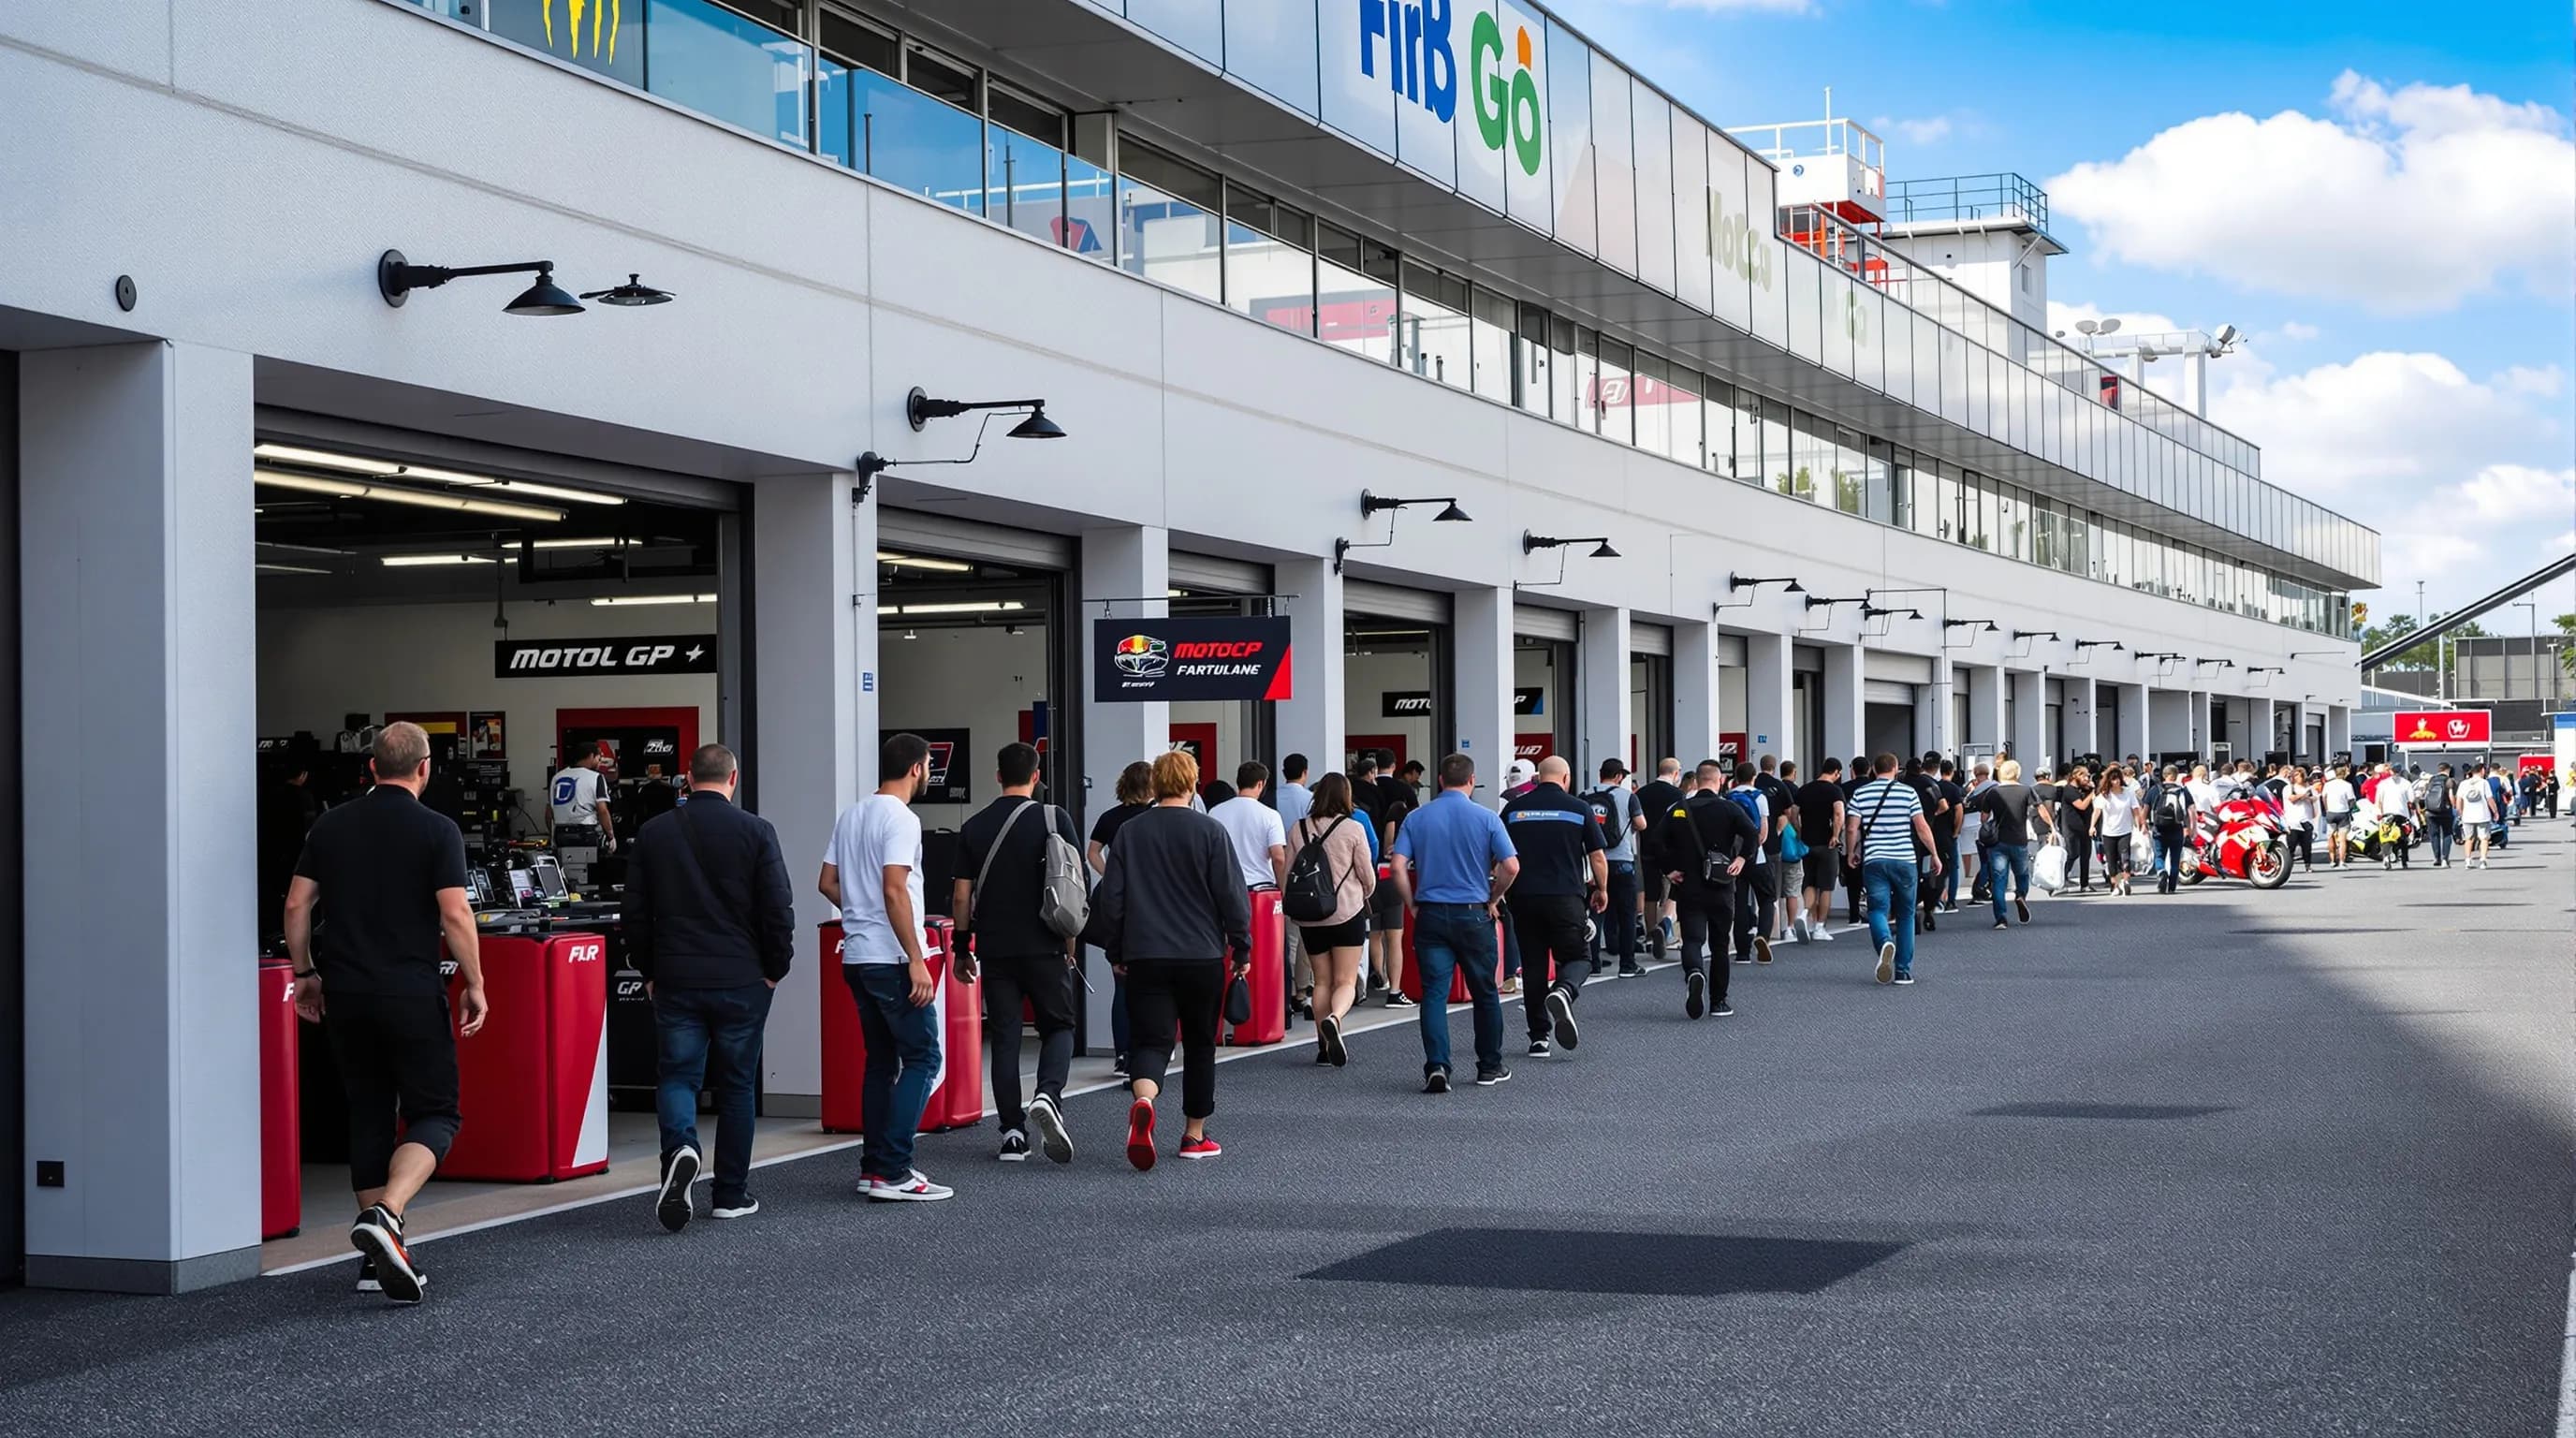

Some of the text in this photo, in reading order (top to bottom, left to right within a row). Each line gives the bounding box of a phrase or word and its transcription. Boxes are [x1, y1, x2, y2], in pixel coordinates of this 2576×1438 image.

[509, 645, 675, 668] MOTOL GP
[1177, 664, 1262, 676] FARTULANE
